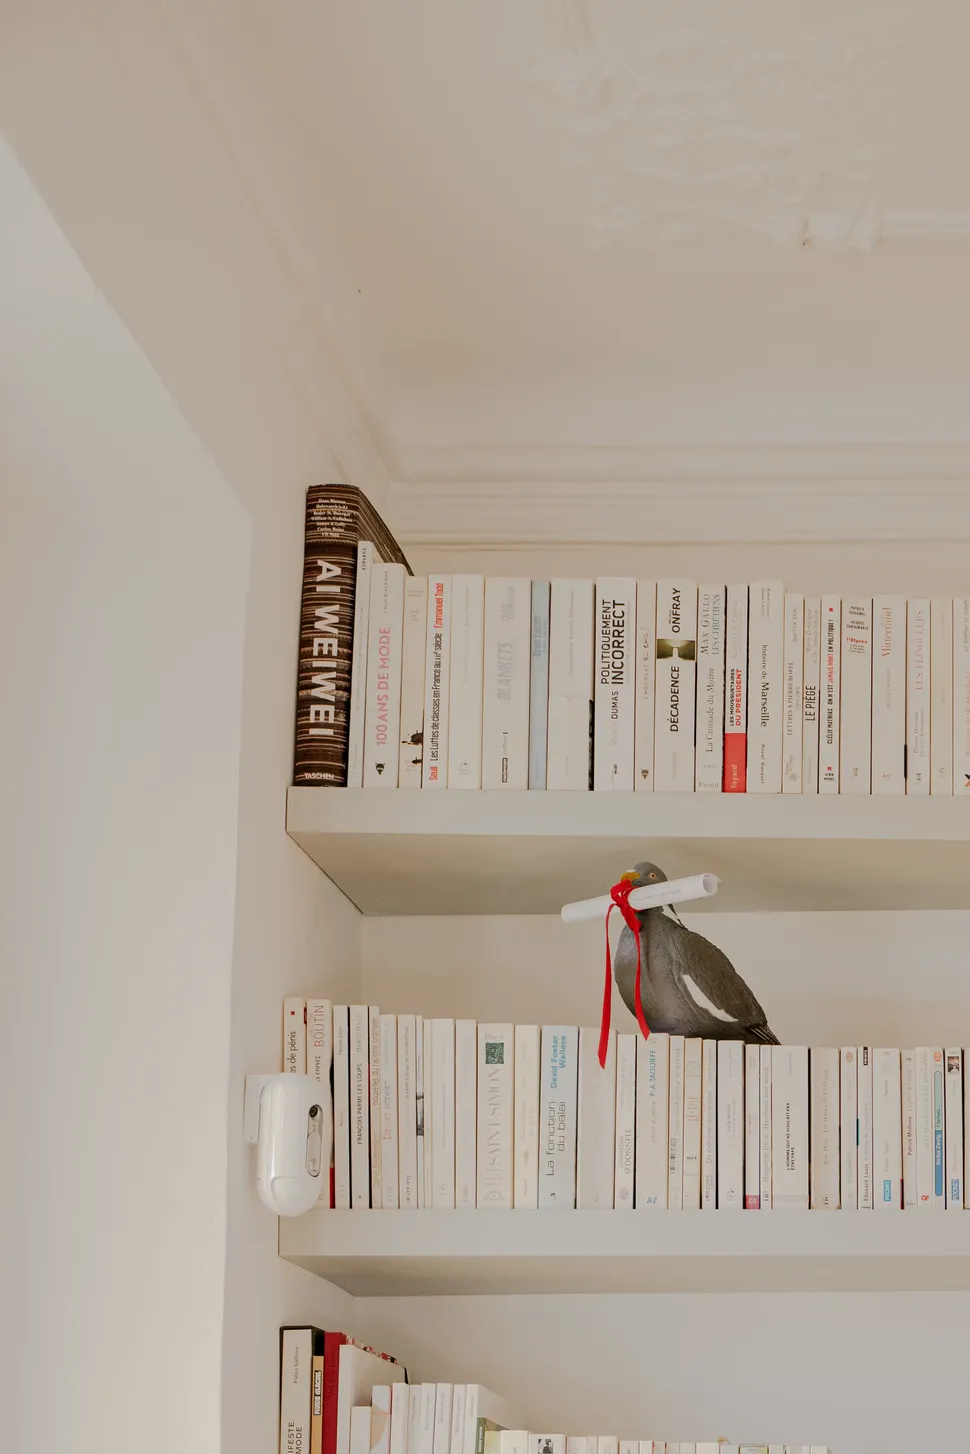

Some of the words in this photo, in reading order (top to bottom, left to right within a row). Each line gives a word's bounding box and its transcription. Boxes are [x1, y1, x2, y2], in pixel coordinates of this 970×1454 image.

[316, 560, 342, 592] AI
[434, 583, 444, 597] Todd
[433, 598, 444, 628] Emmanuel
[672, 587, 681, 633] ONFRAY
[433, 633, 443, 651] siècle
[600, 599, 611, 685] POLITIQUEMENT
[611, 599, 625, 685] INCORRECT
[881, 607, 892, 657] Mitterrand
[378, 626, 391, 668] MODE
[309, 604, 340, 735] WEIWEI
[377, 673, 389, 690] DE
[432, 669, 441, 690] France
[497, 641, 512, 701] BLANKETS
[707, 667, 715, 693] Moine
[763, 670, 767, 679] de
[434, 690, 441, 698] en
[667, 666, 680, 732] DÉCADENCE
[708, 695, 714, 704] du
[734, 668, 742, 713] PRÉSIDENT
[803, 685, 816, 709] PIÈGE
[376, 694, 389, 722] ANS
[432, 699, 441, 722] classes
[611, 691, 619, 719] DUMAS
[760, 682, 770, 727] Marseille
[805, 711, 816, 721] LE
[431, 722, 440, 730] de
[735, 715, 742, 726] DU
[376, 725, 387, 747] 100
[430, 731, 440, 750] Luttes
[705, 742, 714, 753] La
[429, 751, 439, 761] Les
[304, 772, 334, 780] TASCHEN
[429, 766, 439, 781] Seuil
[730, 764, 739, 789] fayard
[314, 1005, 324, 1047] BOUTIN
[289, 1031, 298, 1052] pénis
[558, 1035, 567, 1068] Wallace
[289, 1053, 296, 1064] de
[550, 1064, 558, 1088] David
[487, 1068, 501, 1166] SAINT-SIMON
[557, 1101, 566, 1130] balai
[545, 1101, 556, 1155] fonction
[556, 1135, 565, 1152] du
[545, 1161, 555, 1176] La
[951, 1179, 959, 1200] POCKET
